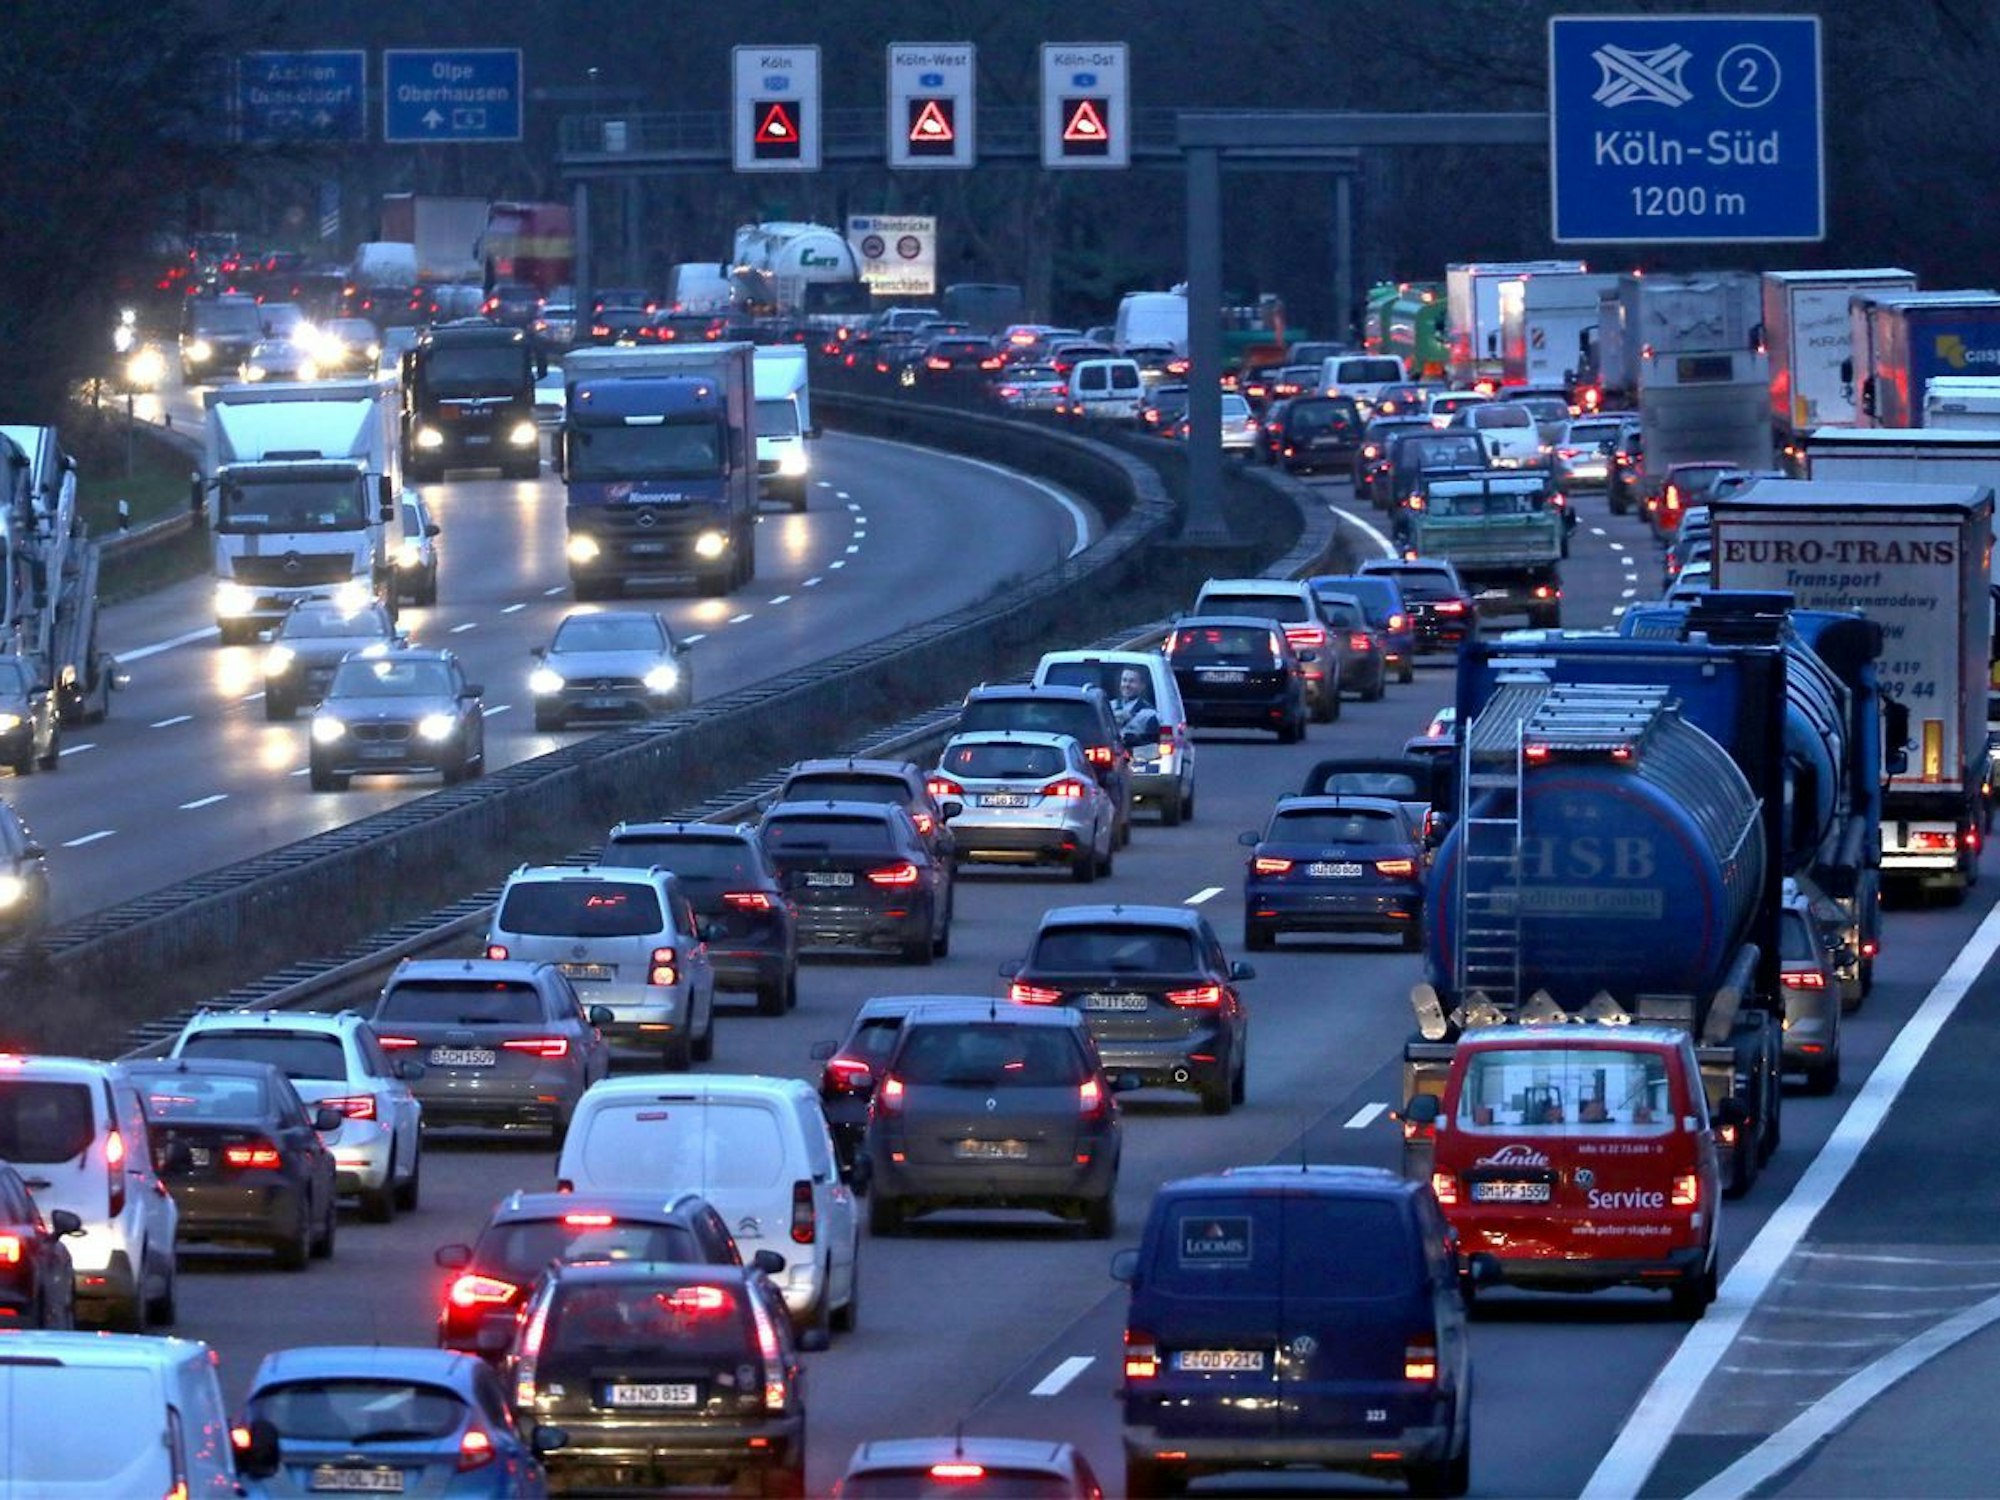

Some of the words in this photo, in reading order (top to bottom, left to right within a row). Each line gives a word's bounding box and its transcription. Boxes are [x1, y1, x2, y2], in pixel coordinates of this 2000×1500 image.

[761, 56, 792, 68] Köln
[896, 54, 967, 66] Köln-West
[1054, 54, 1114, 66] Köln-Ost
[432, 62, 474, 82] Olpe
[1738, 58, 1759, 92] 2
[398, 84, 510, 101] Oberhausen
[1595, 130, 1780, 165] Köln-Süd
[1631, 186, 1706, 216] 1200
[1714, 192, 1745, 215] m
[1723, 540, 1955, 565] EURO-TRANS
[1787, 568, 1882, 590] Transport
[1911, 681, 1936, 698] 44
[1504, 836, 1657, 879] HSB
[1475, 1144, 1550, 1168] Linde
[1503, 1185, 1516, 1198] PF
[1520, 1185, 1549, 1198] 1559
[1588, 1187, 1664, 1209] Service
[1224, 1351, 1261, 1366] 9214
[662, 1386, 690, 1401] 815
